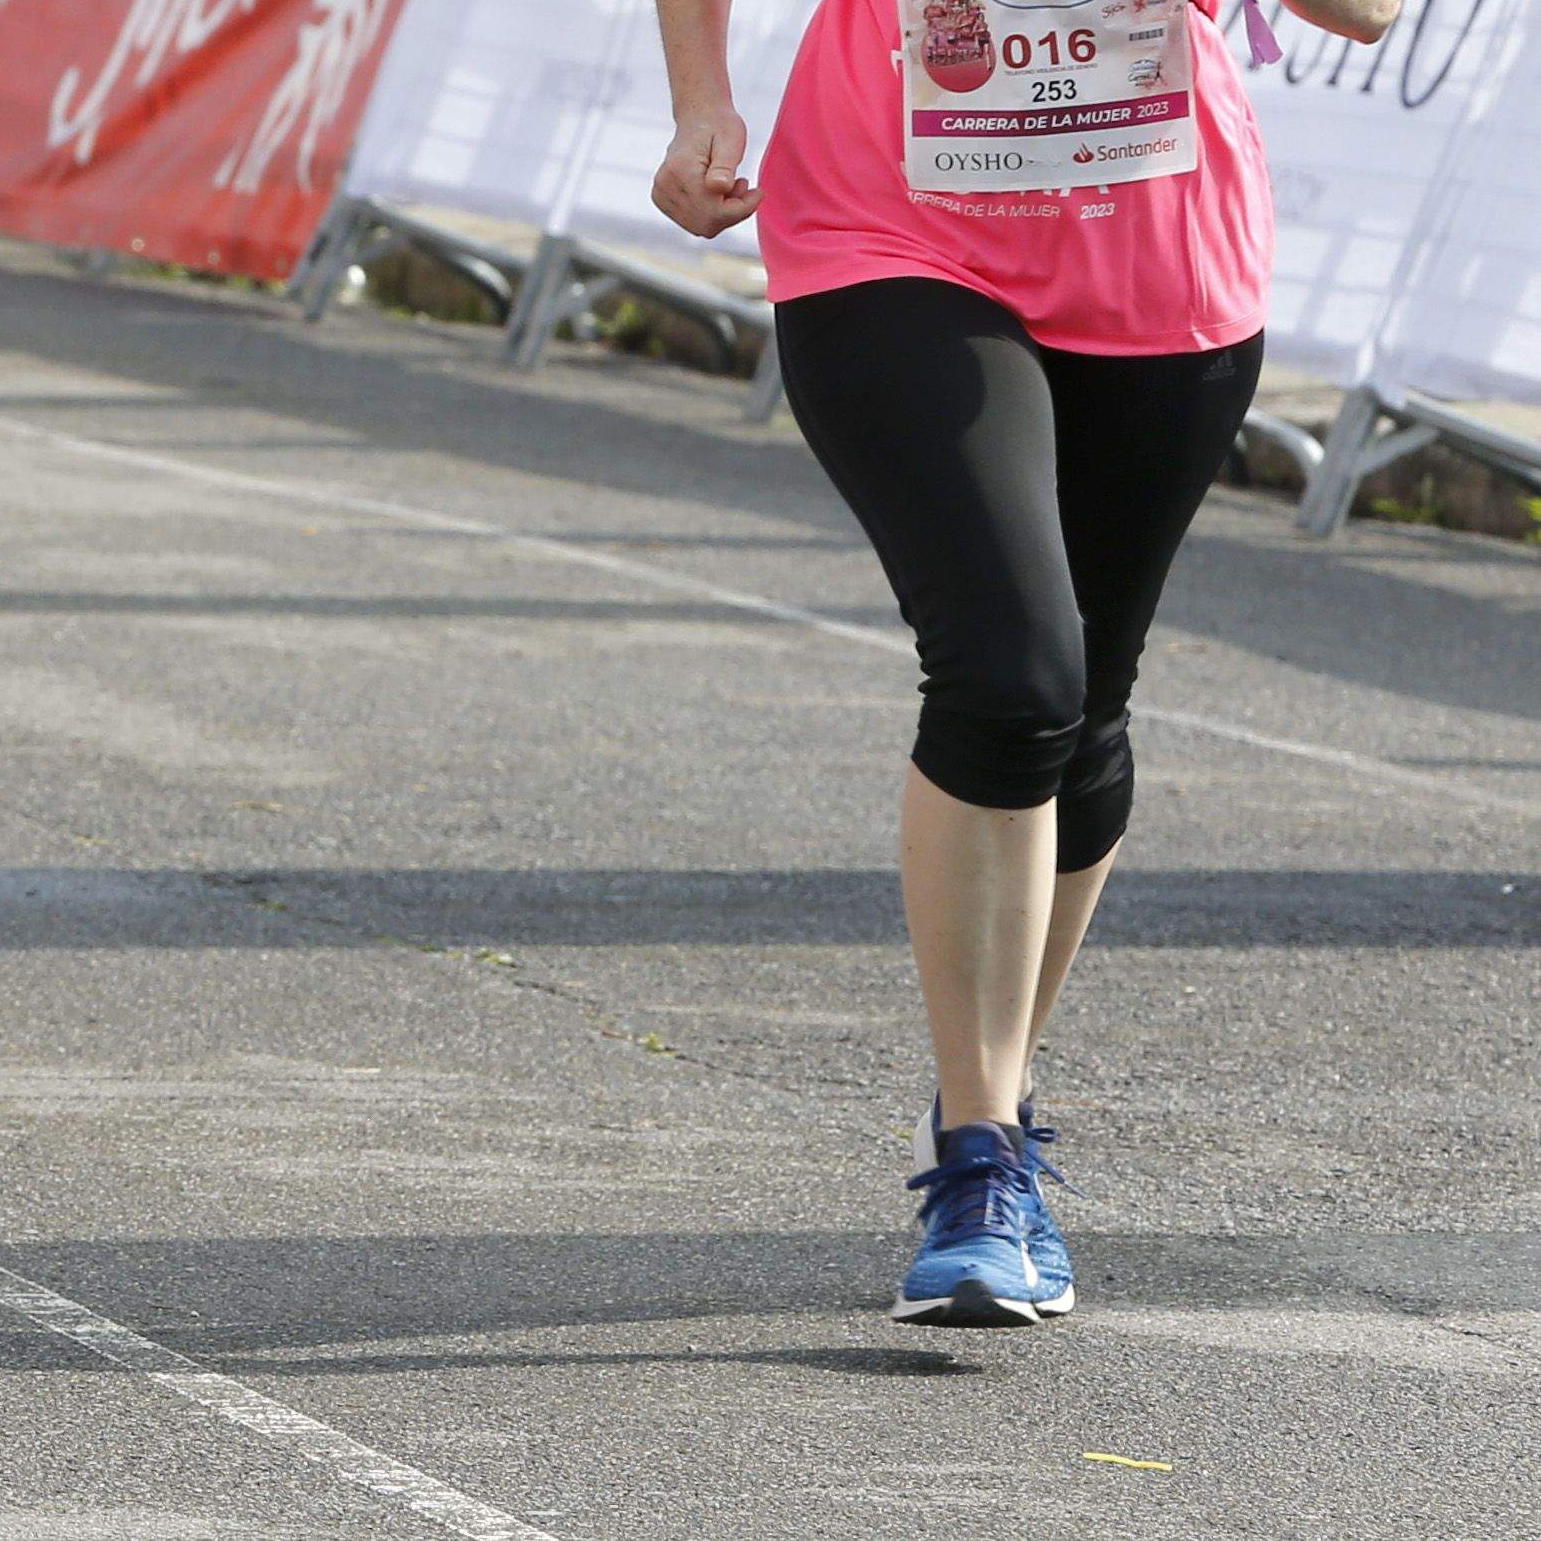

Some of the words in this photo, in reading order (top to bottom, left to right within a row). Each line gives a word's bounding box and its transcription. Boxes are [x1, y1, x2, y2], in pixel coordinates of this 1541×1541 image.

[1002, 29, 1097, 69] 016
[1032, 79, 1077, 102] 253
[941, 116, 1019, 131] CARRERA
[1024, 115, 1048, 130] DE
[1051, 113, 1074, 127] LA
[1076, 108, 1132, 126] MUJER
[1136, 101, 1169, 118] 2023
[1097, 136, 1178, 161] Santander
[935, 152, 1023, 171] OYSHO
[963, 203, 985, 217] DE
[987, 205, 1006, 217] LA
[1009, 205, 1061, 219] MUJER
[1079, 202, 1115, 220] 2023
